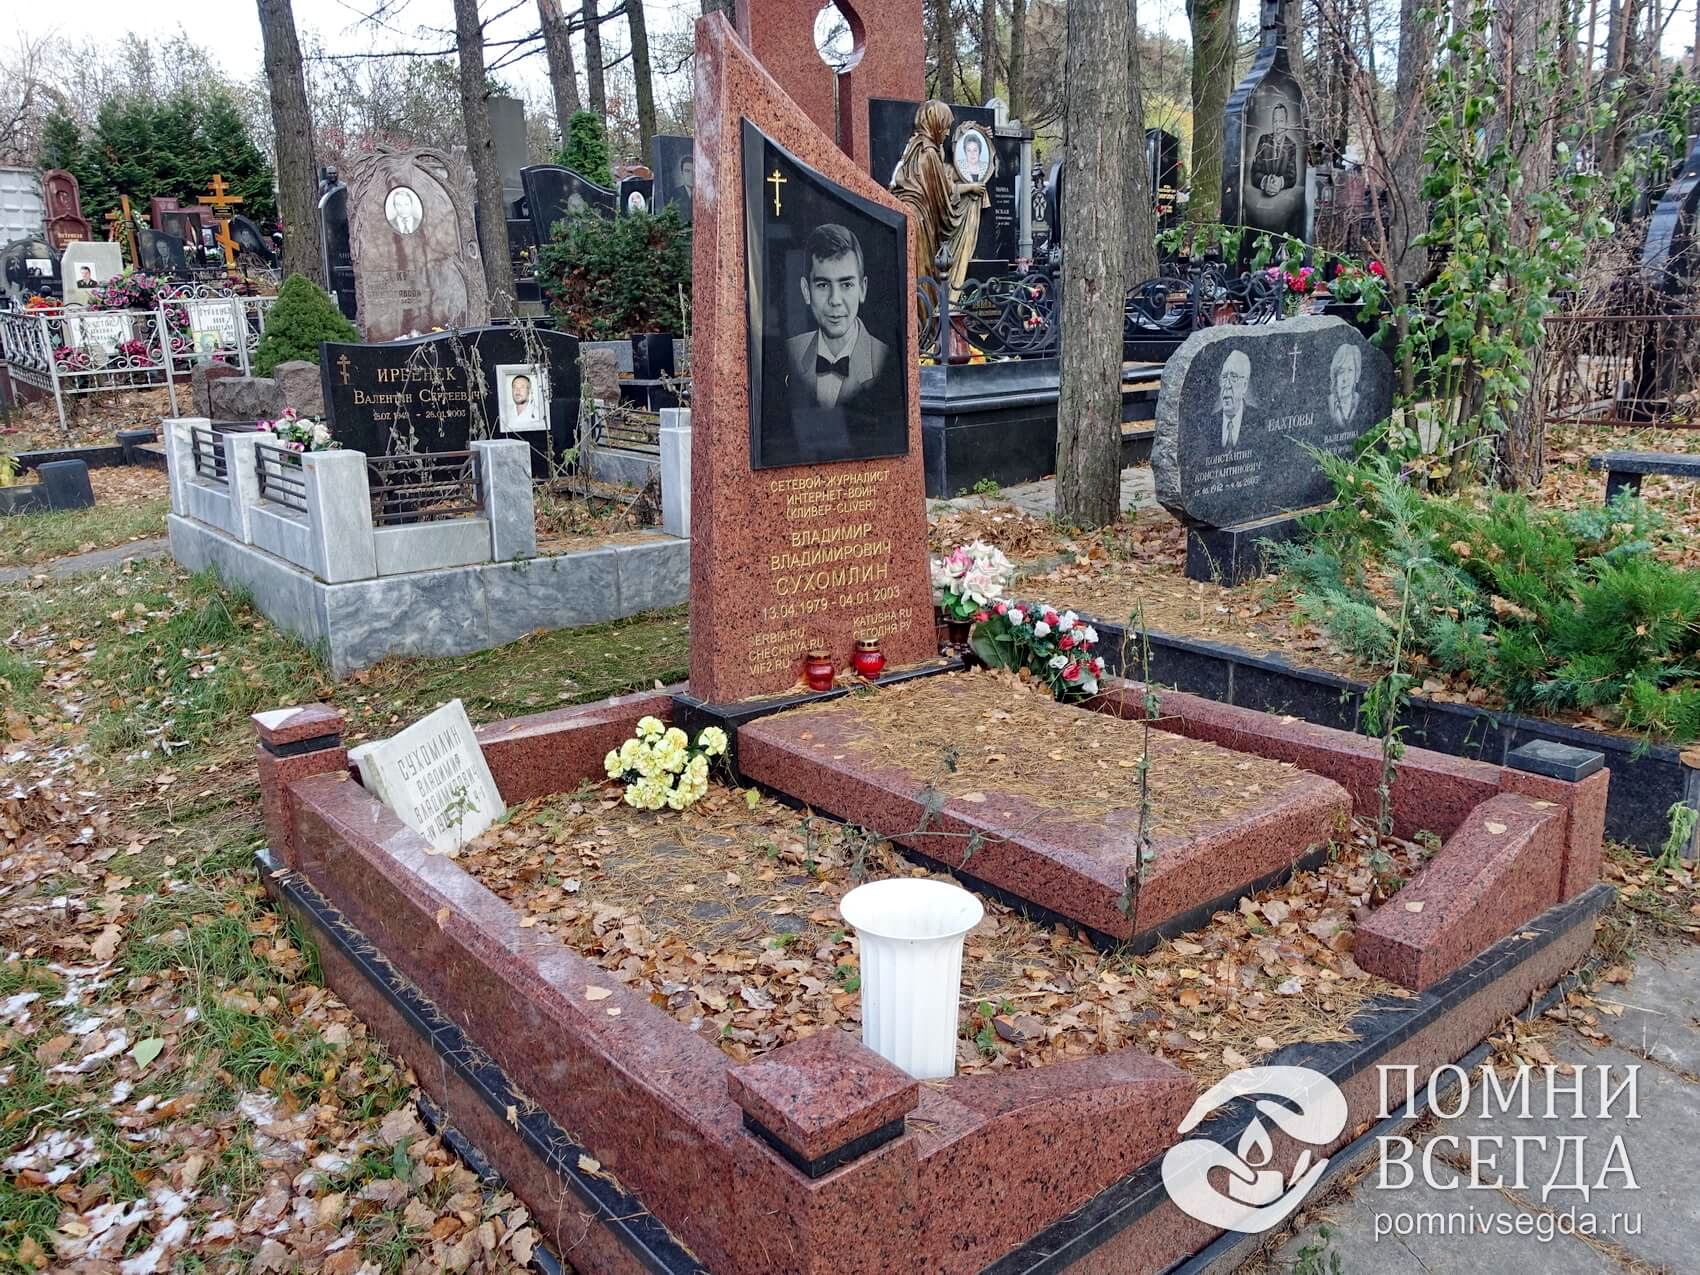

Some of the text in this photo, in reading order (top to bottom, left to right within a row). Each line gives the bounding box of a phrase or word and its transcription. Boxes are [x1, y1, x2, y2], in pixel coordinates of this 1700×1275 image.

[792, 523, 873, 547] ВЛАДИМИР
[771, 539, 891, 571] ВЛАДИМИРОВИЧ
[776, 562, 888, 596] СУХОМЛИН
[748, 636, 824, 661] CHECHNYA.RU
[397, 725, 461, 781] СУХОМЛИН
